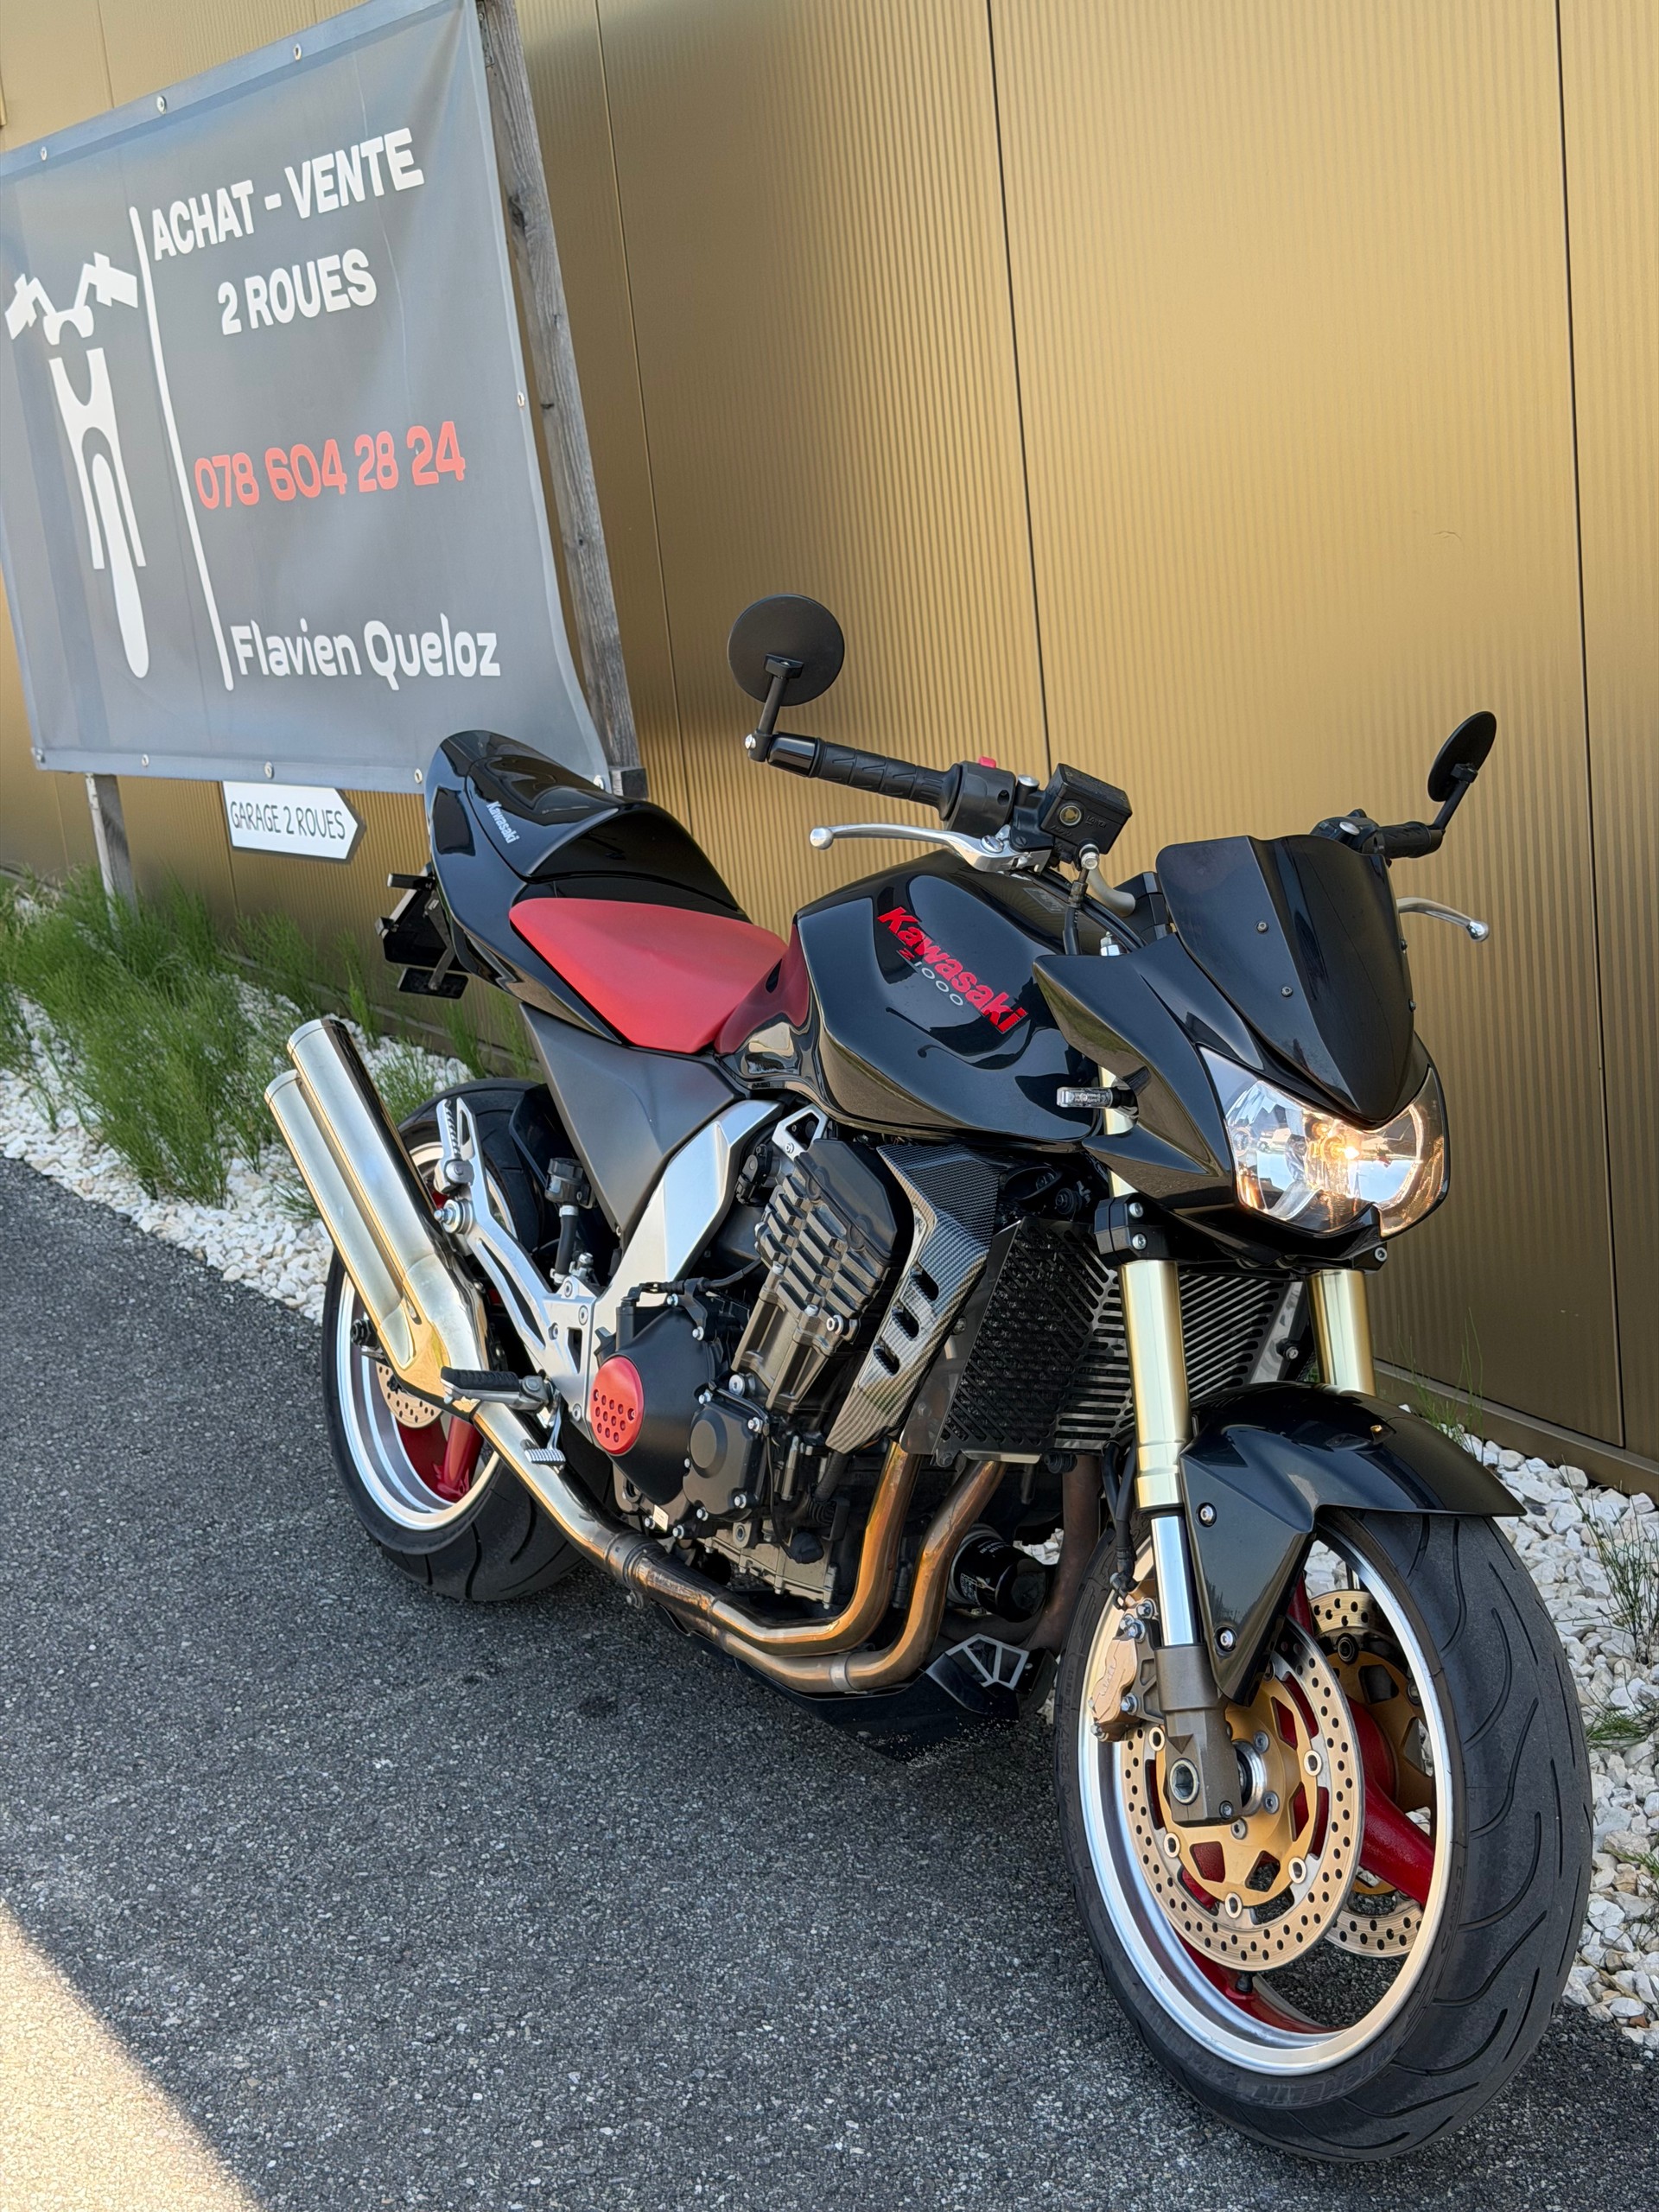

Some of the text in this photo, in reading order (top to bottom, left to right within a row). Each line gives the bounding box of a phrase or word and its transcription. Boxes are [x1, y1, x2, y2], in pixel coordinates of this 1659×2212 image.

[152, 127, 424, 261] ACHAT - VENTE
[218, 248, 378, 335] 2 ROUES
[194, 421, 466, 509] 078 604 28 24
[230, 609, 501, 690] Flavien Queloz
[230, 801, 345, 840] GARAGE 2 ROUES
[486, 800, 520, 844] Kawasaki
[877, 906, 1028, 1034] Kawasaki
